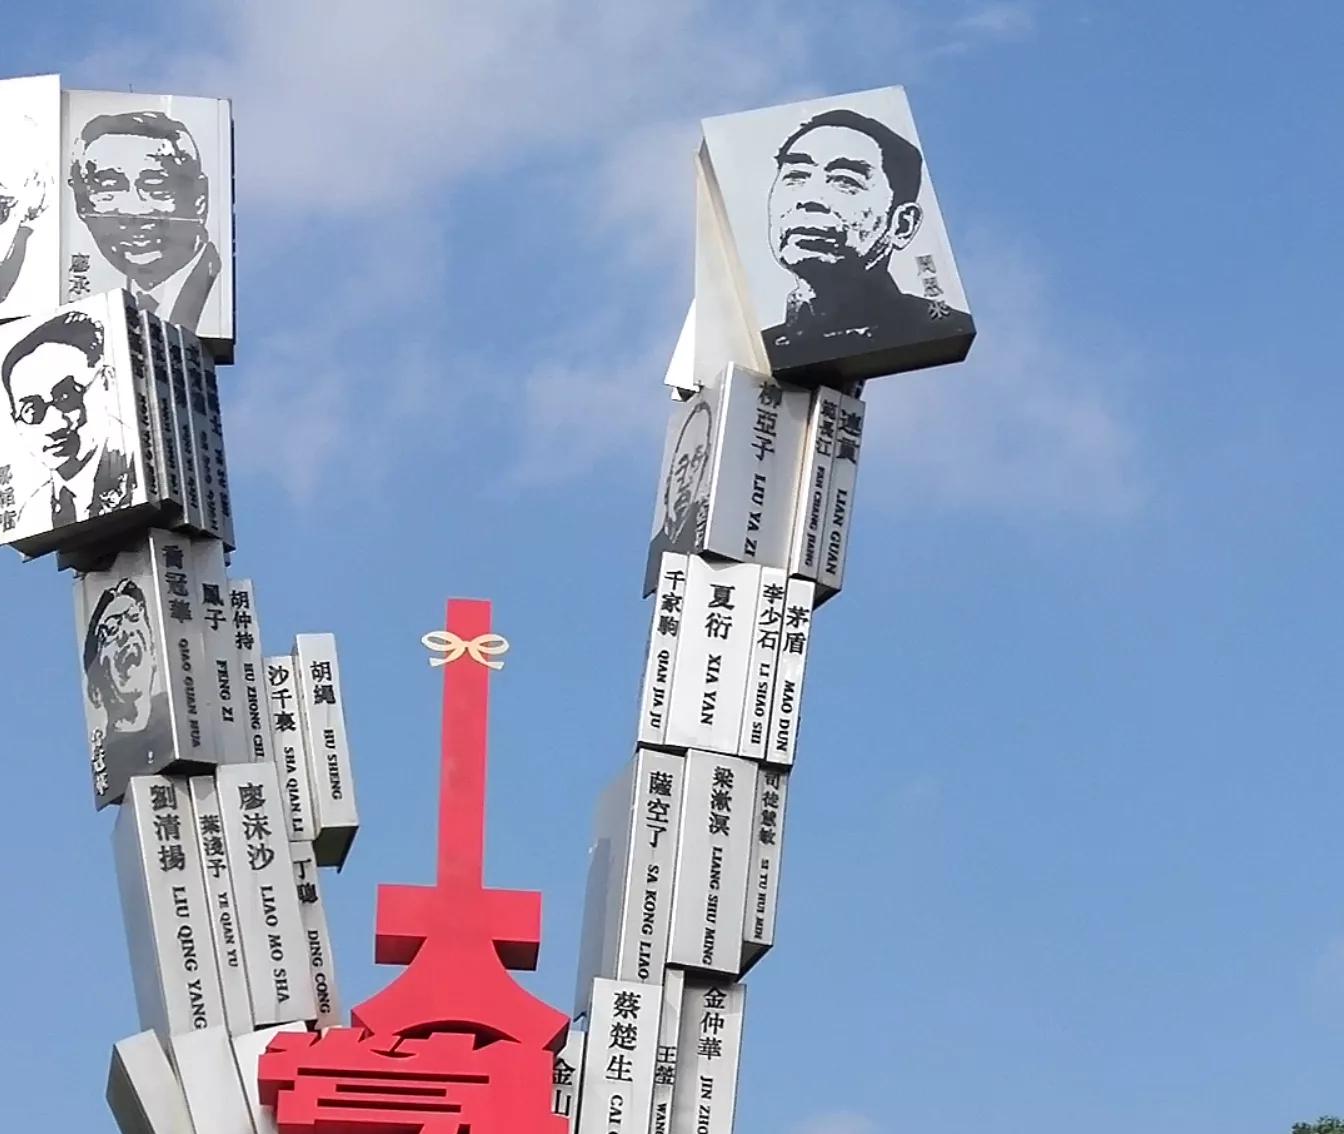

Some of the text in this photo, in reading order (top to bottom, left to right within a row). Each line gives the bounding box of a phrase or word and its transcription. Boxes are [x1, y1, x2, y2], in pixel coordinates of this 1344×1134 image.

[69, 252, 91, 303] 廖承
[751, 473, 766, 506] LIU
[833, 488, 848, 527] LIAN
[747, 512, 762, 531] YA
[744, 537, 757, 557] ZI
[825, 530, 841, 575] GUAN
[229, 590, 255, 650] 胡仲持
[247, 686, 262, 730] ZHONG
[650, 570, 685, 728] 千家駒 QIAN JIA JU
[700, 583, 736, 725] 夏衍 XIA YAN
[216, 660, 231, 701] FENG
[760, 662, 770, 677] LI
[777, 605, 809, 751] 茅盾 MAO DUN
[222, 706, 234, 723] ZI
[323, 729, 336, 749] HU
[284, 746, 297, 773] SHA
[327, 754, 343, 800] SHENG
[286, 778, 302, 813] QIAN
[293, 817, 304, 833] LI
[646, 864, 660, 884] SA
[709, 846, 723, 890] LIANG
[759, 873, 769, 890] TU
[172, 886, 190, 918] LIU
[218, 891, 229, 909] YE
[260, 886, 278, 927] LIAO
[641, 889, 657, 936] KONG
[706, 894, 719, 924] SHU
[220, 912, 235, 945] QIAN
[702, 927, 716, 965] MING
[177, 925, 199, 972] QING
[226, 949, 238, 967] YU
[268, 934, 284, 962] MO
[307, 930, 323, 968] DING
[638, 941, 652, 980] LIAO
[187, 979, 208, 1029] YANG
[274, 968, 291, 1004] SHA
[314, 973, 331, 1013] CONG
[605, 991, 642, 1083] 蔡楚生
[697, 986, 728, 1061] 金仲華
[700, 1076, 714, 1100] JIN
[608, 1094, 624, 1124] CAI
